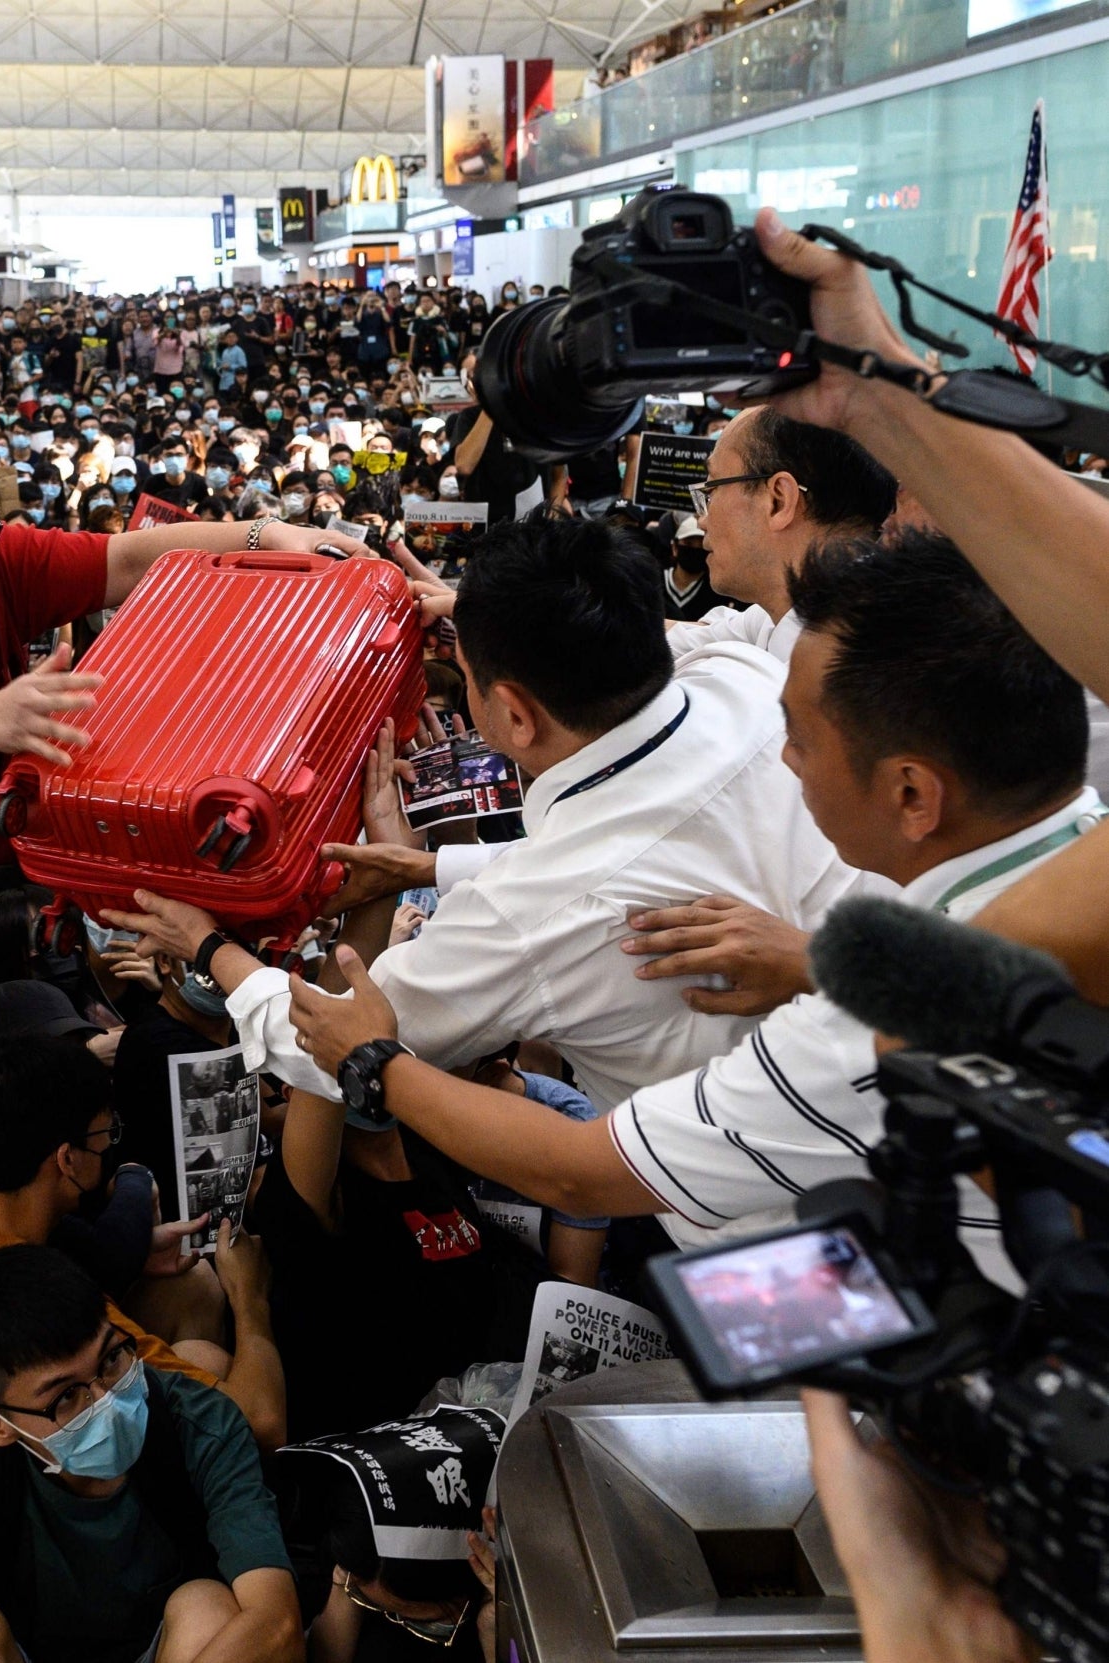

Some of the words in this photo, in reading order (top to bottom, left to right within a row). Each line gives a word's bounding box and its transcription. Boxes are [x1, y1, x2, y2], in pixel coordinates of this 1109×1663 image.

[677, 349, 709, 358] Canon
[649, 445, 674, 457] WHY
[674, 449, 691, 459] are
[693, 451, 707, 460] we
[406, 512, 448, 521] 2019.8.11
[511, 1215, 525, 1224] OF
[555, 1309, 609, 1337] POWER
[612, 1329, 621, 1342] &
[565, 1299, 621, 1328] POLICE
[622, 1321, 663, 1347] ABUSE
[570, 1327, 593, 1346] ON
[598, 1337, 610, 1352] 11
[612, 1344, 641, 1363] AUG
